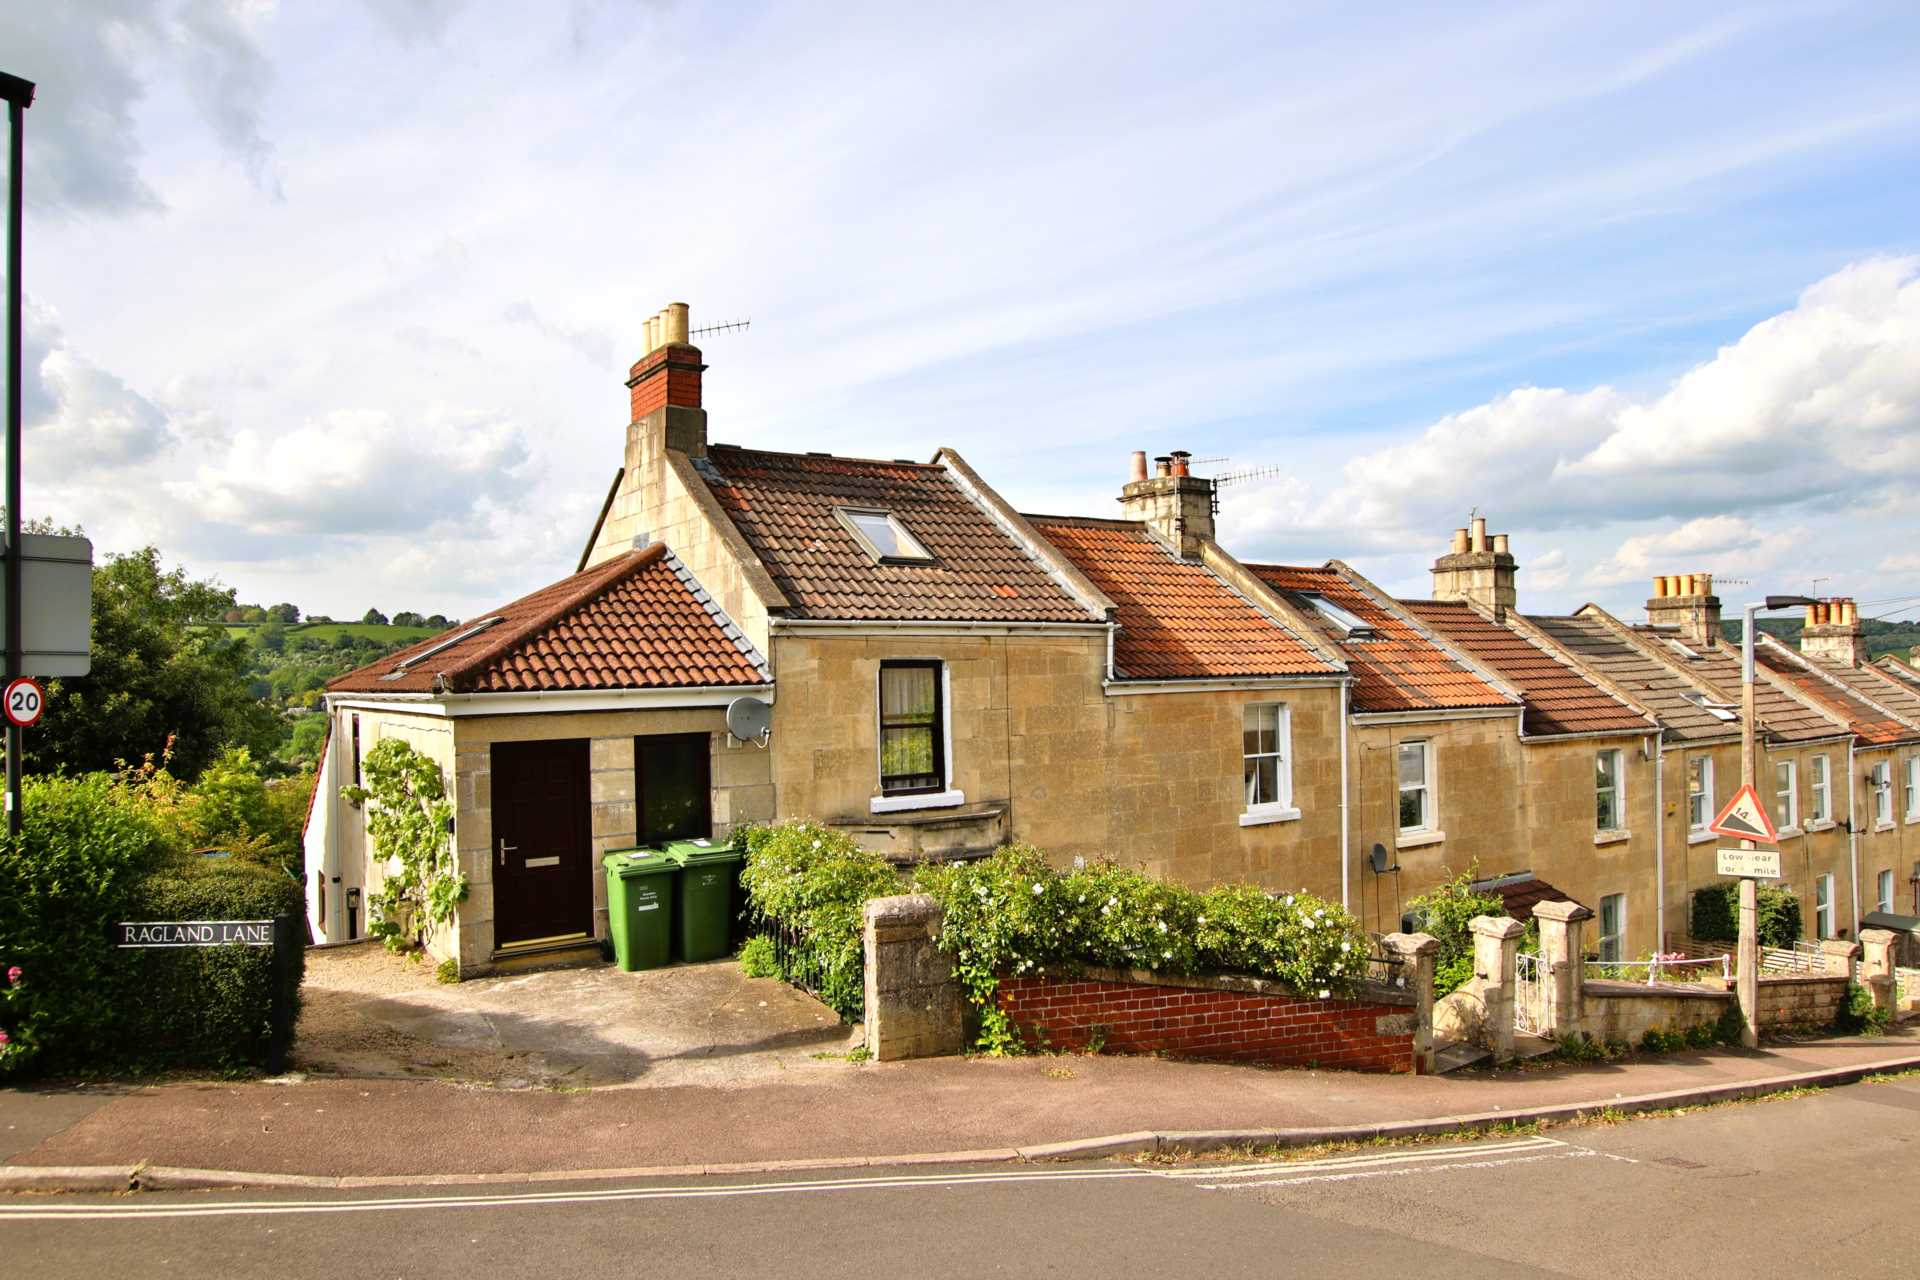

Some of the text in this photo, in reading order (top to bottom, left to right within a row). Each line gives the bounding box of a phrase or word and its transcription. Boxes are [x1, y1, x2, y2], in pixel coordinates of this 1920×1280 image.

[12, 692, 39, 711] 20
[1722, 853, 1772, 862] Low ear
[1753, 867, 1777, 875] mile
[124, 925, 270, 943] RAGLAND LANE
